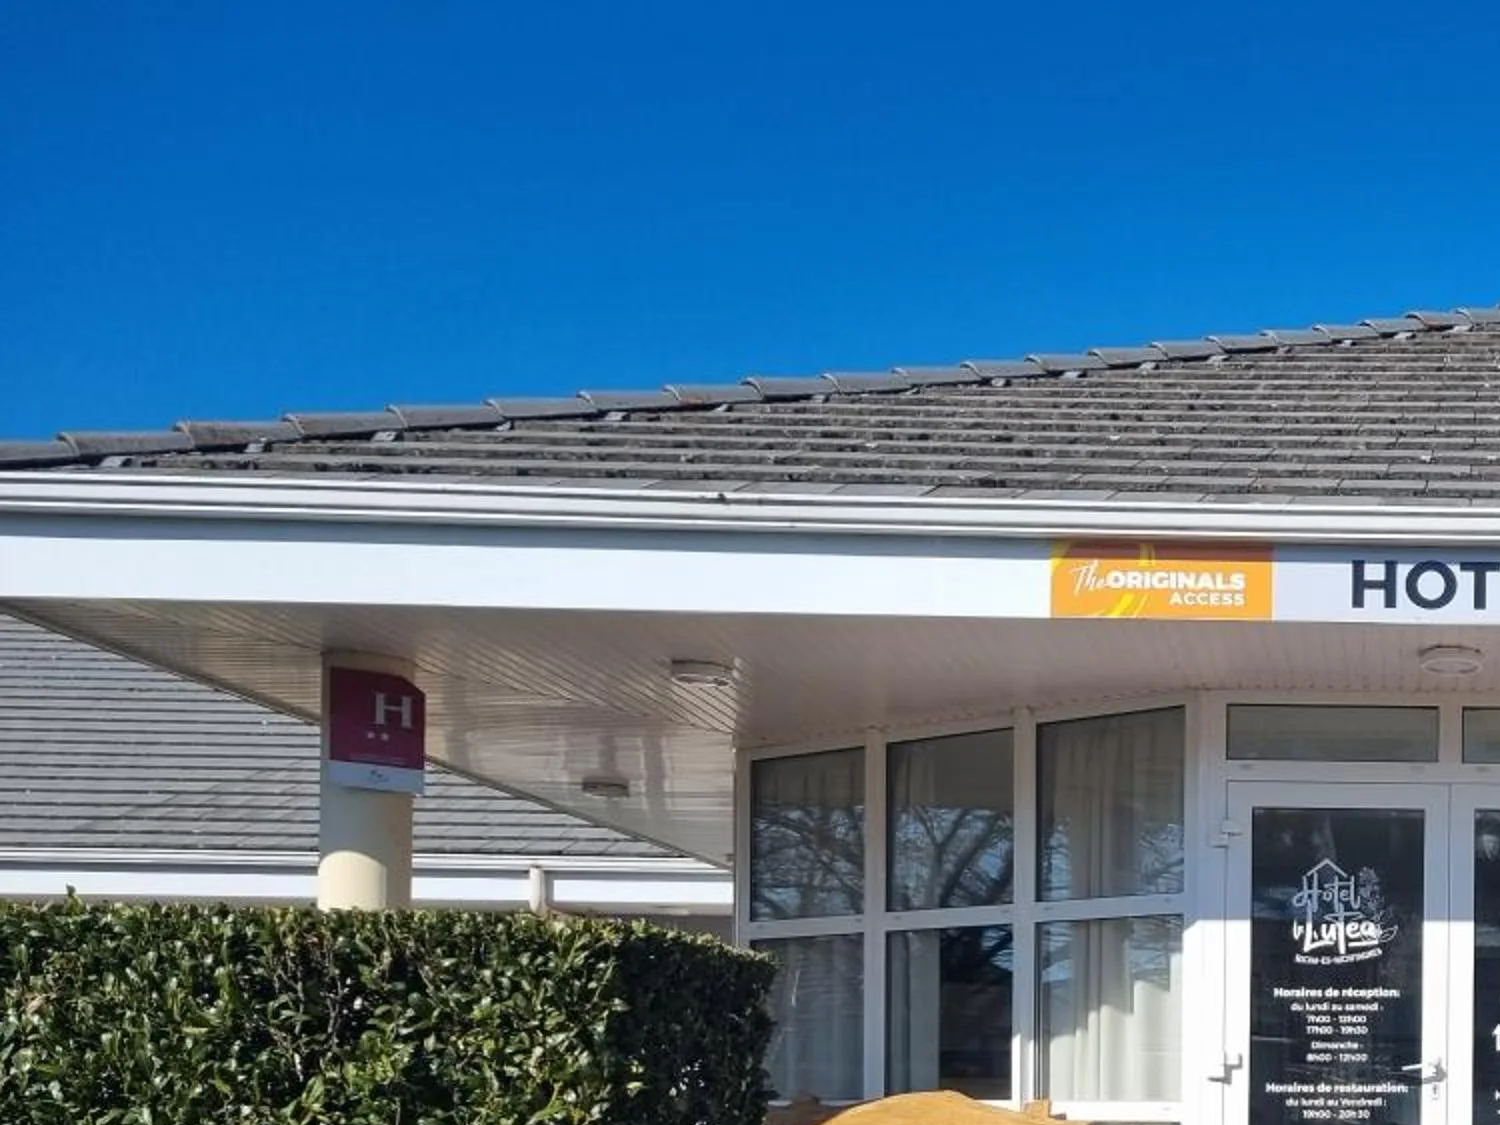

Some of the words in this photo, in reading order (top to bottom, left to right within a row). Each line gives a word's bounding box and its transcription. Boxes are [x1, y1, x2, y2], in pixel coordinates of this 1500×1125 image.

[1108, 571, 1245, 589] ORIGINALS
[1169, 592, 1245, 605] ACCESS
[375, 691, 413, 730] H
[1273, 986, 1323, 998] Horaires
[1324, 986, 1340, 998] de
[1290, 1002, 1304, 1011] du
[1305, 1001, 1330, 1011] lundi
[1331, 1003, 1343, 1011] au
[1344, 1001, 1379, 1011] samedi
[1265, 1083, 1314, 1093] Horaires
[1317, 1083, 1333, 1093] de
[1285, 1098, 1299, 1107] du
[1301, 1098, 1325, 1107] lundi
[1326, 1099, 1338, 1107] au
